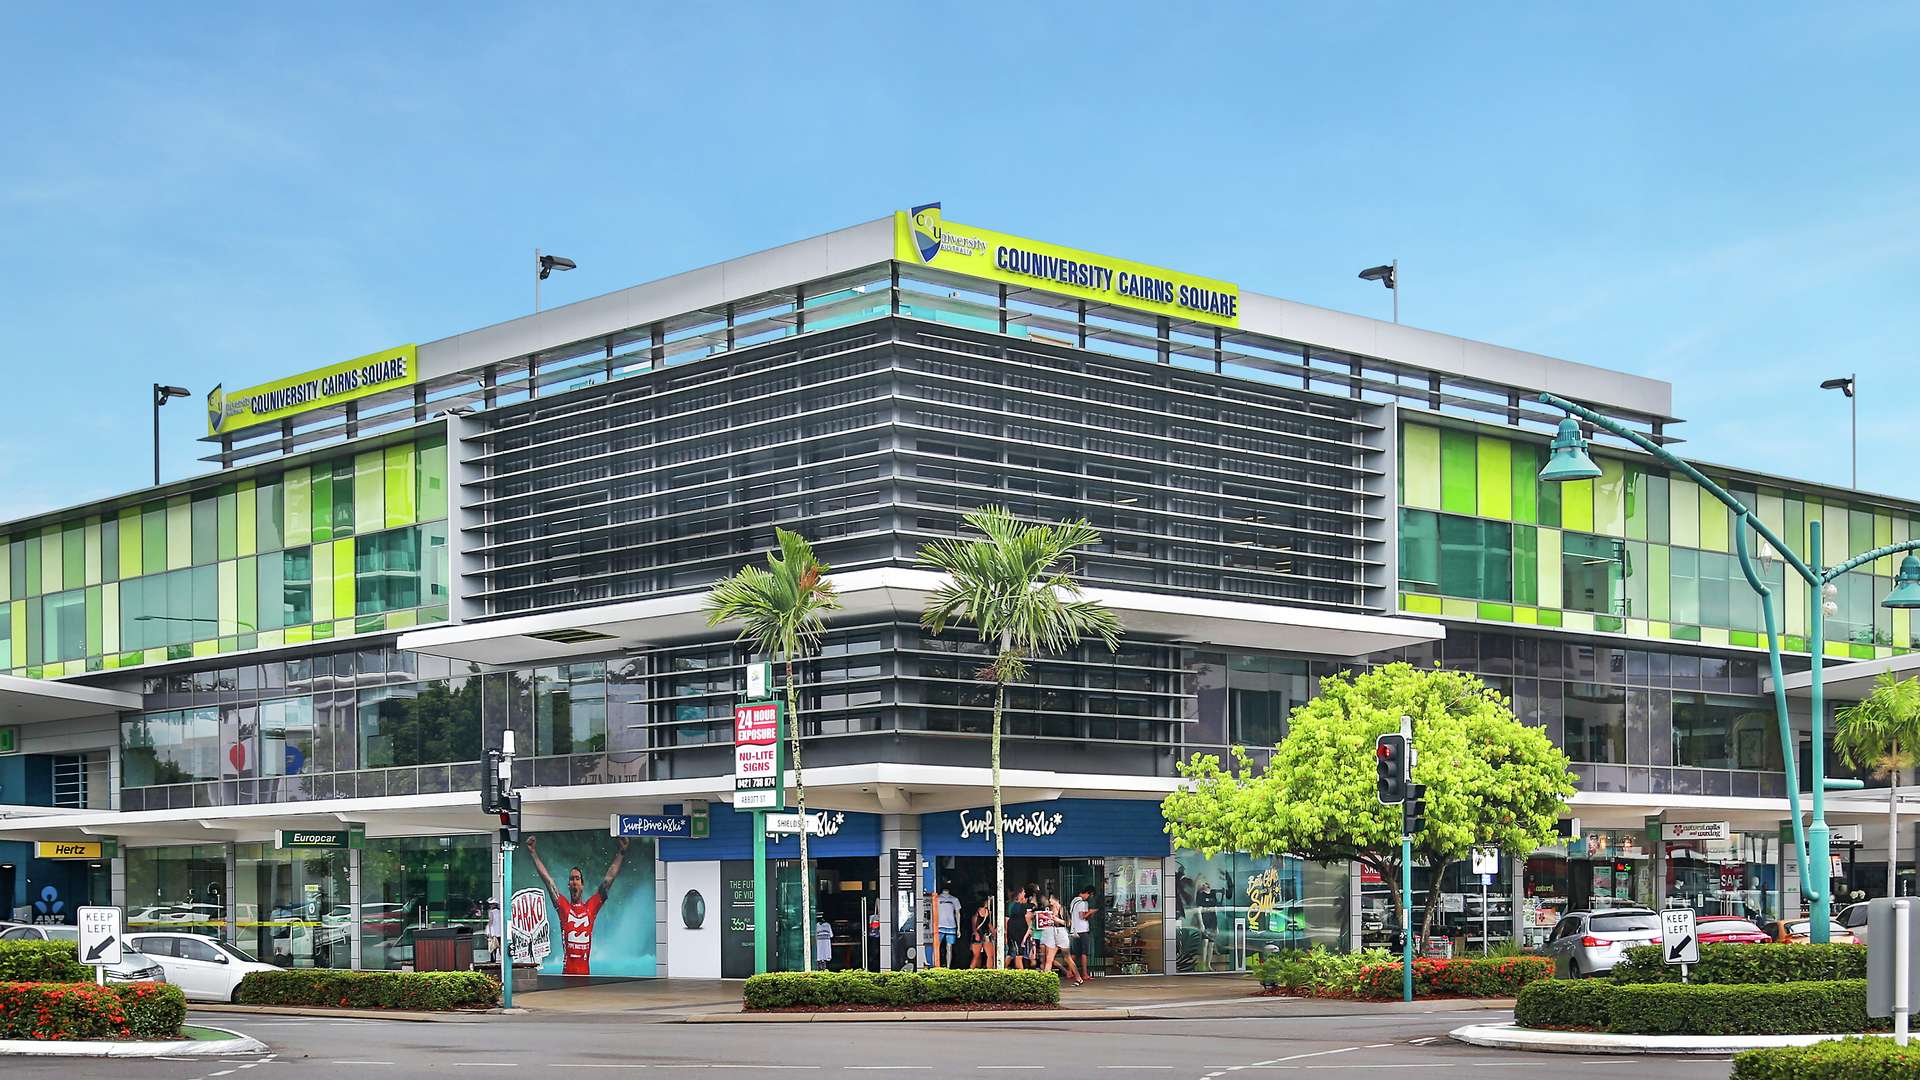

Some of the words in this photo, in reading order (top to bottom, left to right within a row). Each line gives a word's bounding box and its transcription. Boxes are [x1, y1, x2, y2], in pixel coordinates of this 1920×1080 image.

[940, 243, 973, 256] AUSTRALIA
[997, 246, 1113, 292] CQUNIVERSITY
[1118, 271, 1174, 303] CAIRNS
[1178, 284, 1237, 316] SQUARE
[251, 379, 318, 414] CQUNIVERSITY
[322, 369, 358, 396] CAIRNS
[361, 357, 403, 386] SQUARE
[738, 709, 752, 730] 24
[754, 709, 776, 721] HOUR
[738, 728, 776, 741] EXPOSURE
[739, 751, 774, 761] NU-LITE
[743, 762, 770, 772] SIGNS
[293, 833, 336, 843] Europcar
[55, 845, 86, 855] Hertz
[729, 881, 741, 889] THE
[734, 891, 743, 899] OF
[86, 912, 113, 921] KEEP
[511, 894, 543, 933] PARKO
[1666, 914, 1689, 923] KEEP
[34, 915, 62, 925] ANZ
[87, 924, 112, 933] LEFT
[1668, 925, 1689, 934] LEFT
